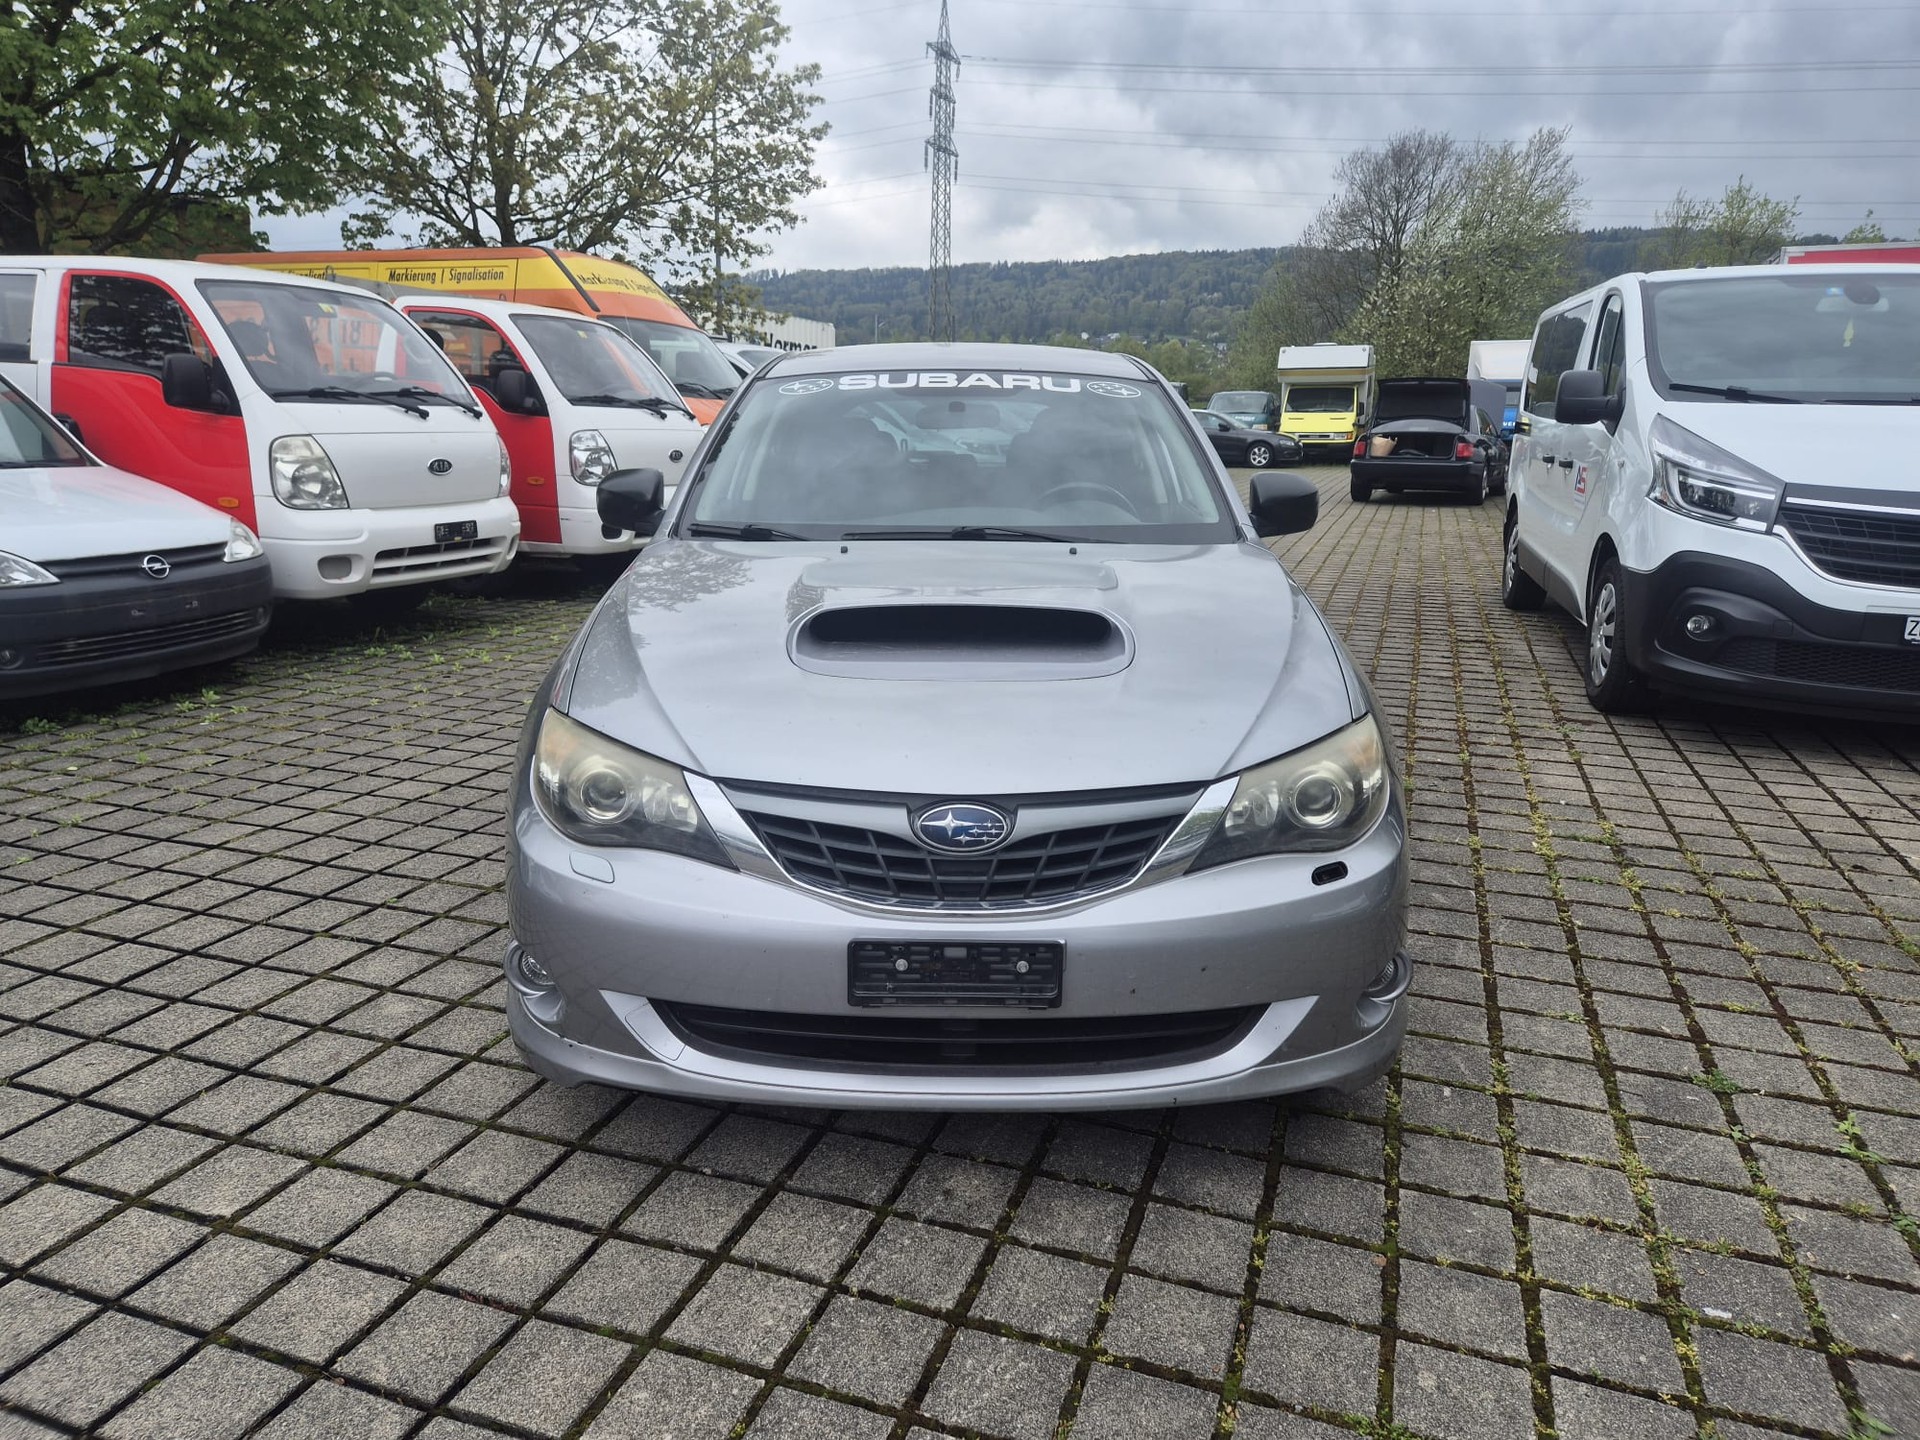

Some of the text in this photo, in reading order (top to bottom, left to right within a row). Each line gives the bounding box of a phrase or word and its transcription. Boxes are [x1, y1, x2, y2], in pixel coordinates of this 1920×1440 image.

[388, 268, 437, 284] Markierung
[448, 266, 504, 284] Signalisation
[838, 373, 1081, 392] SUBARU
[431, 460, 451, 473] KIA
[1907, 619, 1920, 636] Z
